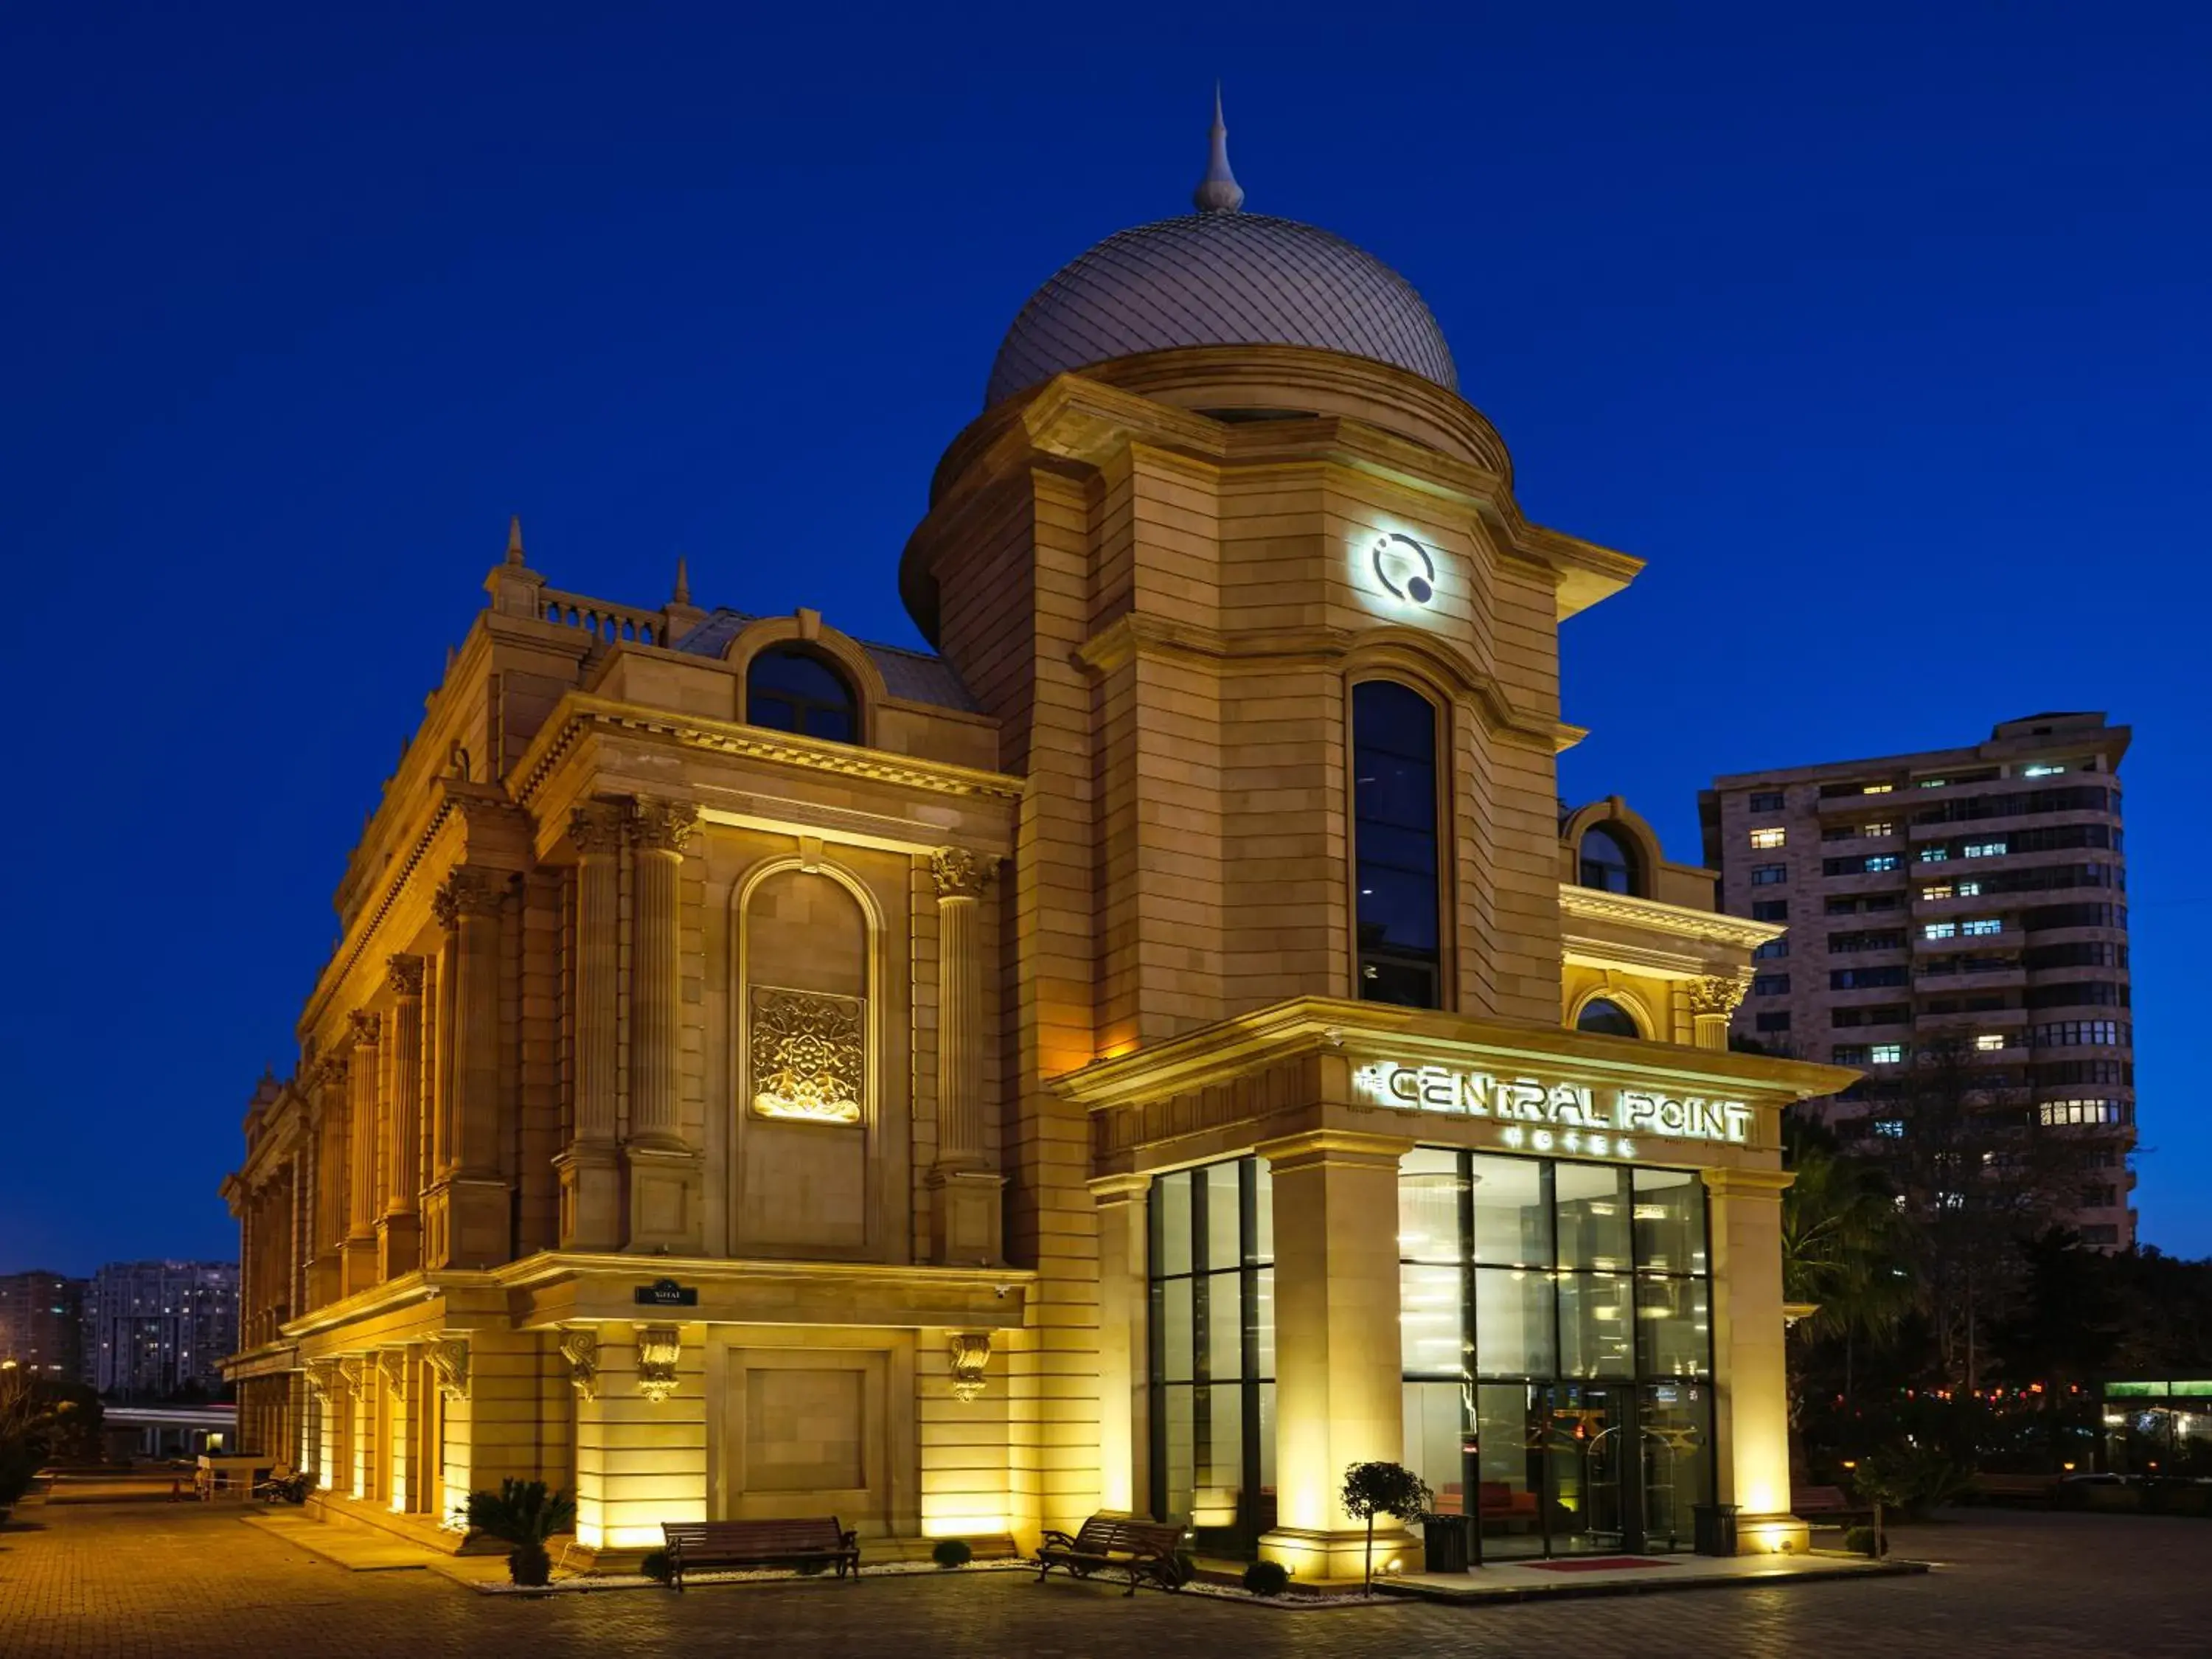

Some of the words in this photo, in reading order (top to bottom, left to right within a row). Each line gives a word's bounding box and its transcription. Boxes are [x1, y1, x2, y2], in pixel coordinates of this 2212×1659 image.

[1389, 1067, 1610, 1122] CENTRAL
[1625, 1093, 1753, 1137] POINT
[1506, 1126, 1635, 1158] HOTEL
